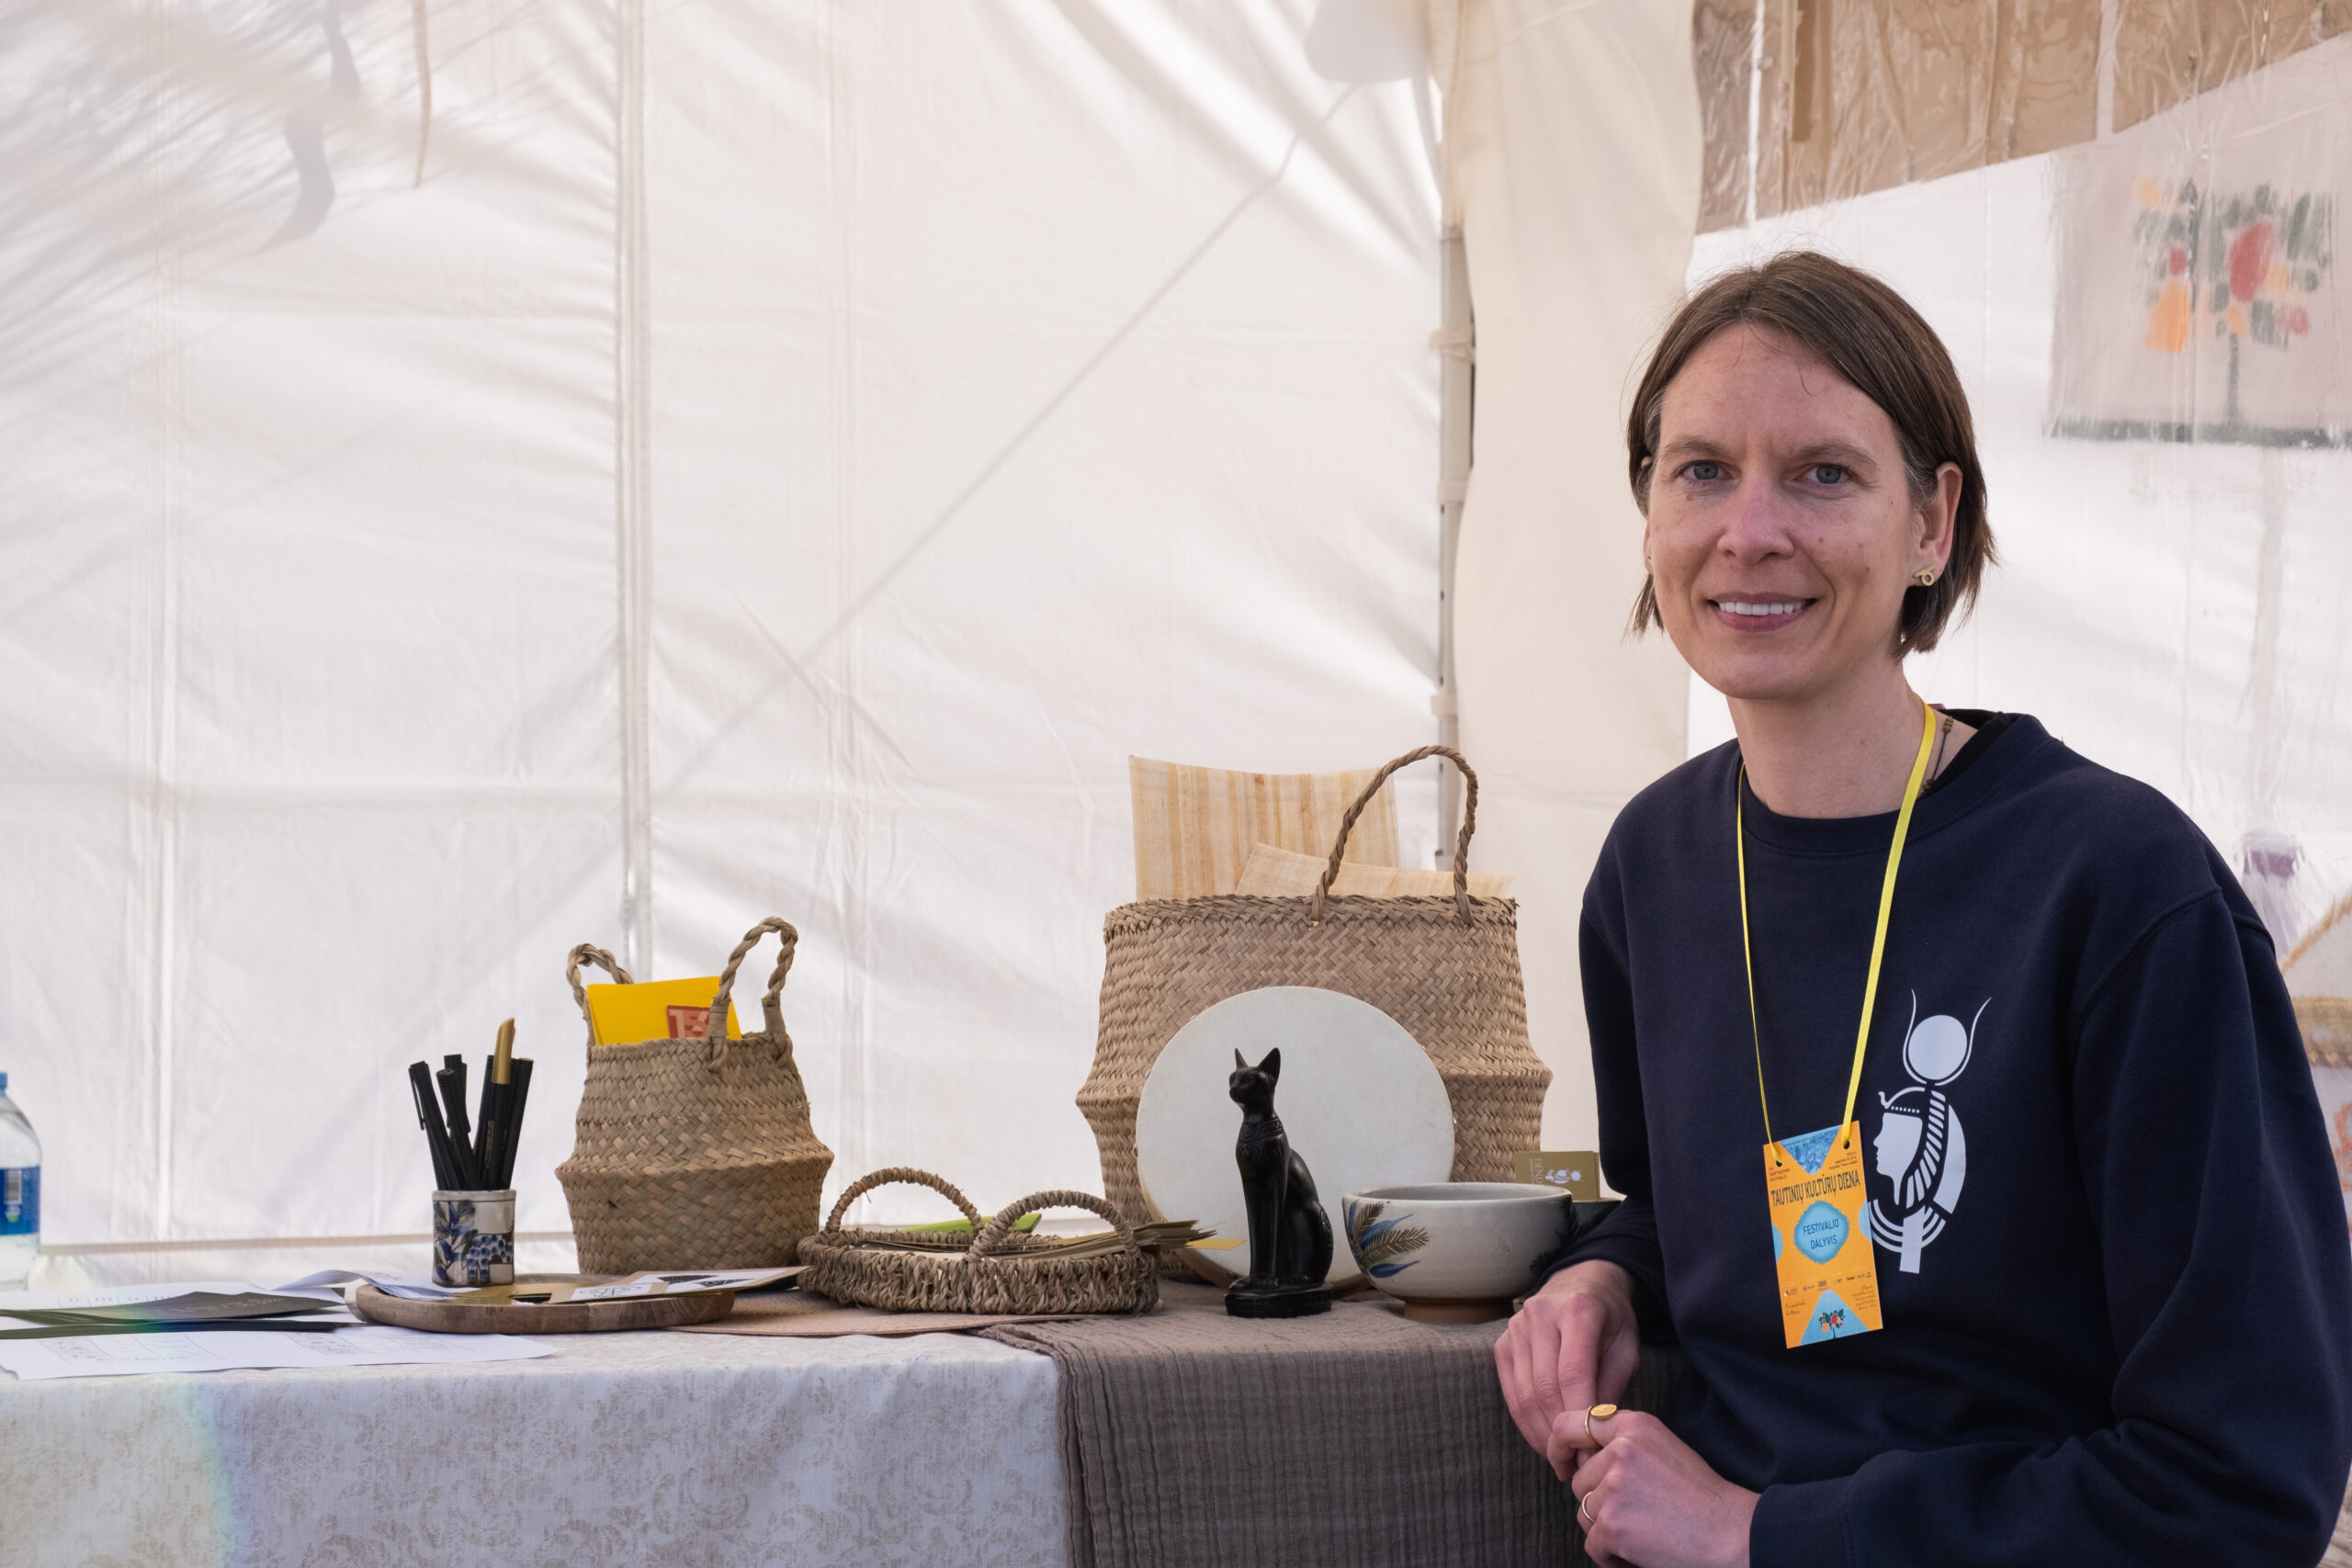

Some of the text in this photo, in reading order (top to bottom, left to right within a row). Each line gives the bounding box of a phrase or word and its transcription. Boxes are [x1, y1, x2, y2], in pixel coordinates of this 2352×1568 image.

[1771, 1184, 1804, 1207] TAUTINIŲ
[1838, 1169, 1860, 1190] DIENA
[1803, 1218, 1839, 1235] FESTIVALIO
[1810, 1235, 1838, 1249] DALYVIS
